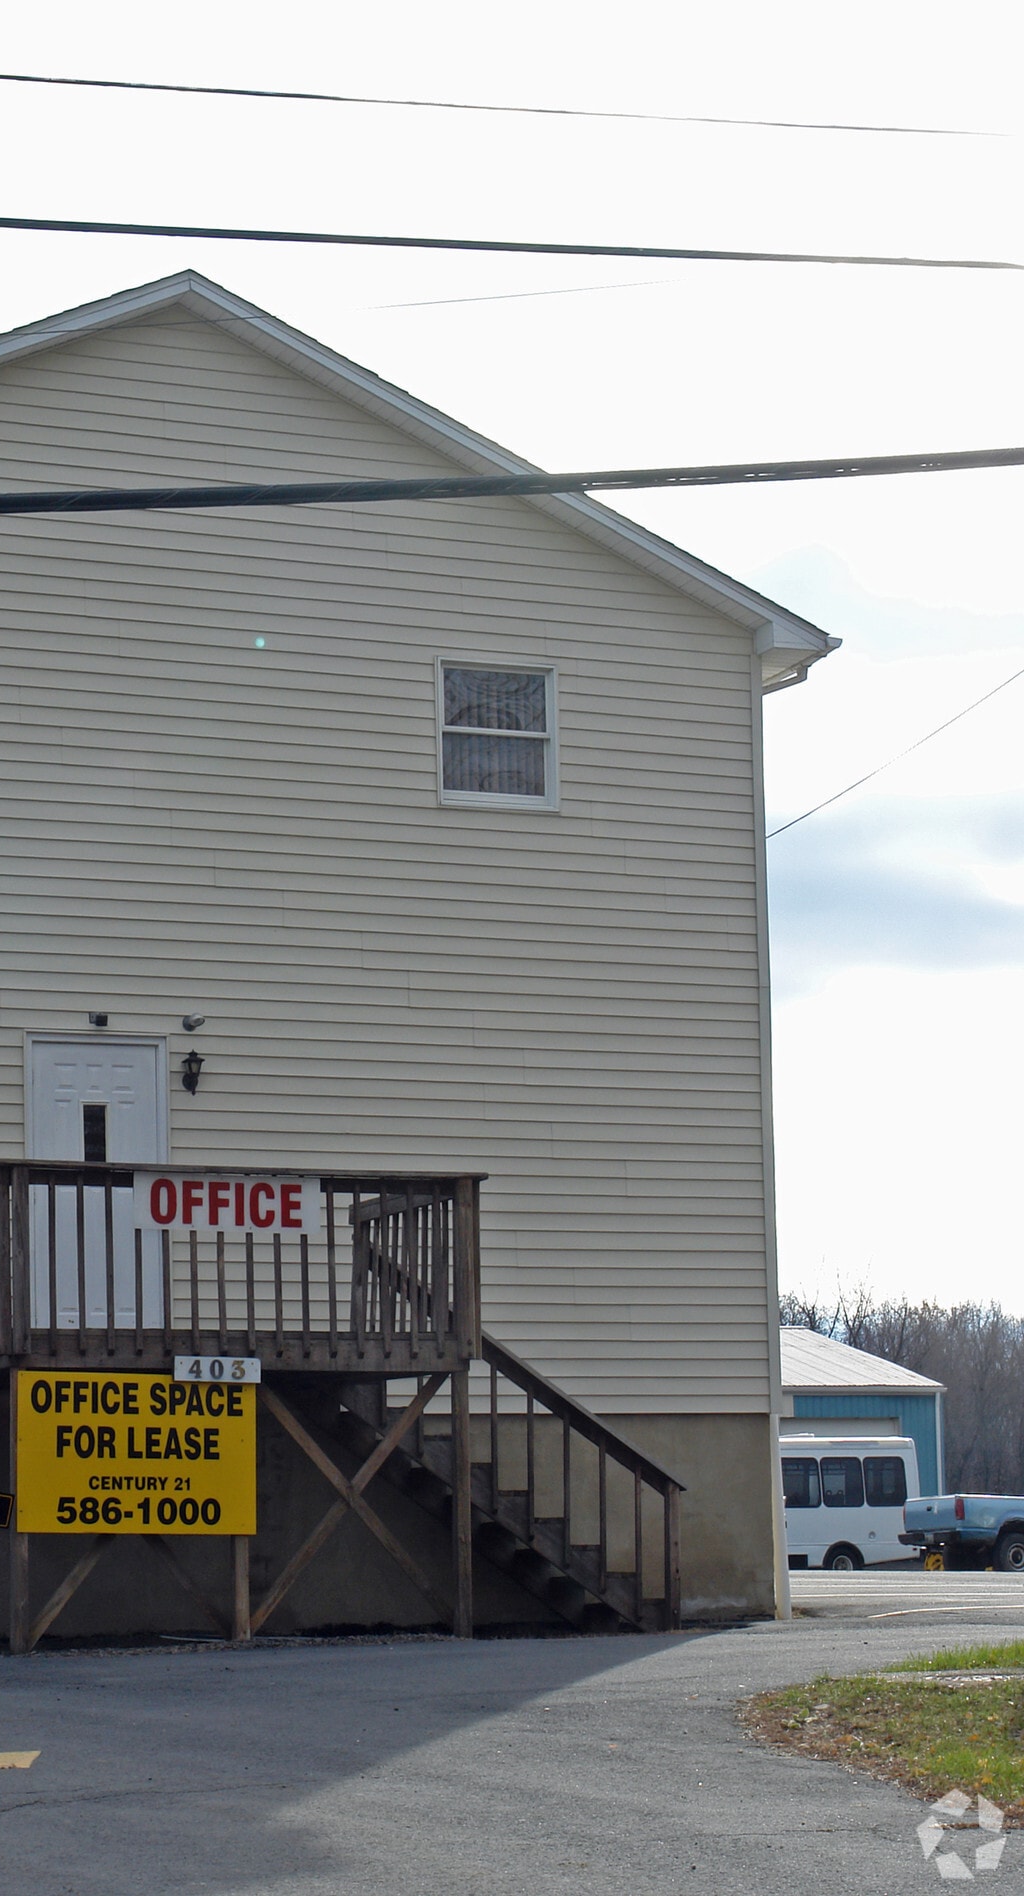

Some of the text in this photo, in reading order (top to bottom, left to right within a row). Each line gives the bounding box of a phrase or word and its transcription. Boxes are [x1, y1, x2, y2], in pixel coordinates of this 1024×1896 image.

[150, 1178, 303, 1228] OFFICE
[188, 1359, 246, 1380] 403
[31, 1380, 243, 1417] OFFICE SPACE
[56, 1425, 220, 1460] FOR LEASE
[88, 1475, 191, 1491] CENTURY 21
[56, 1497, 221, 1525] 586-1000
